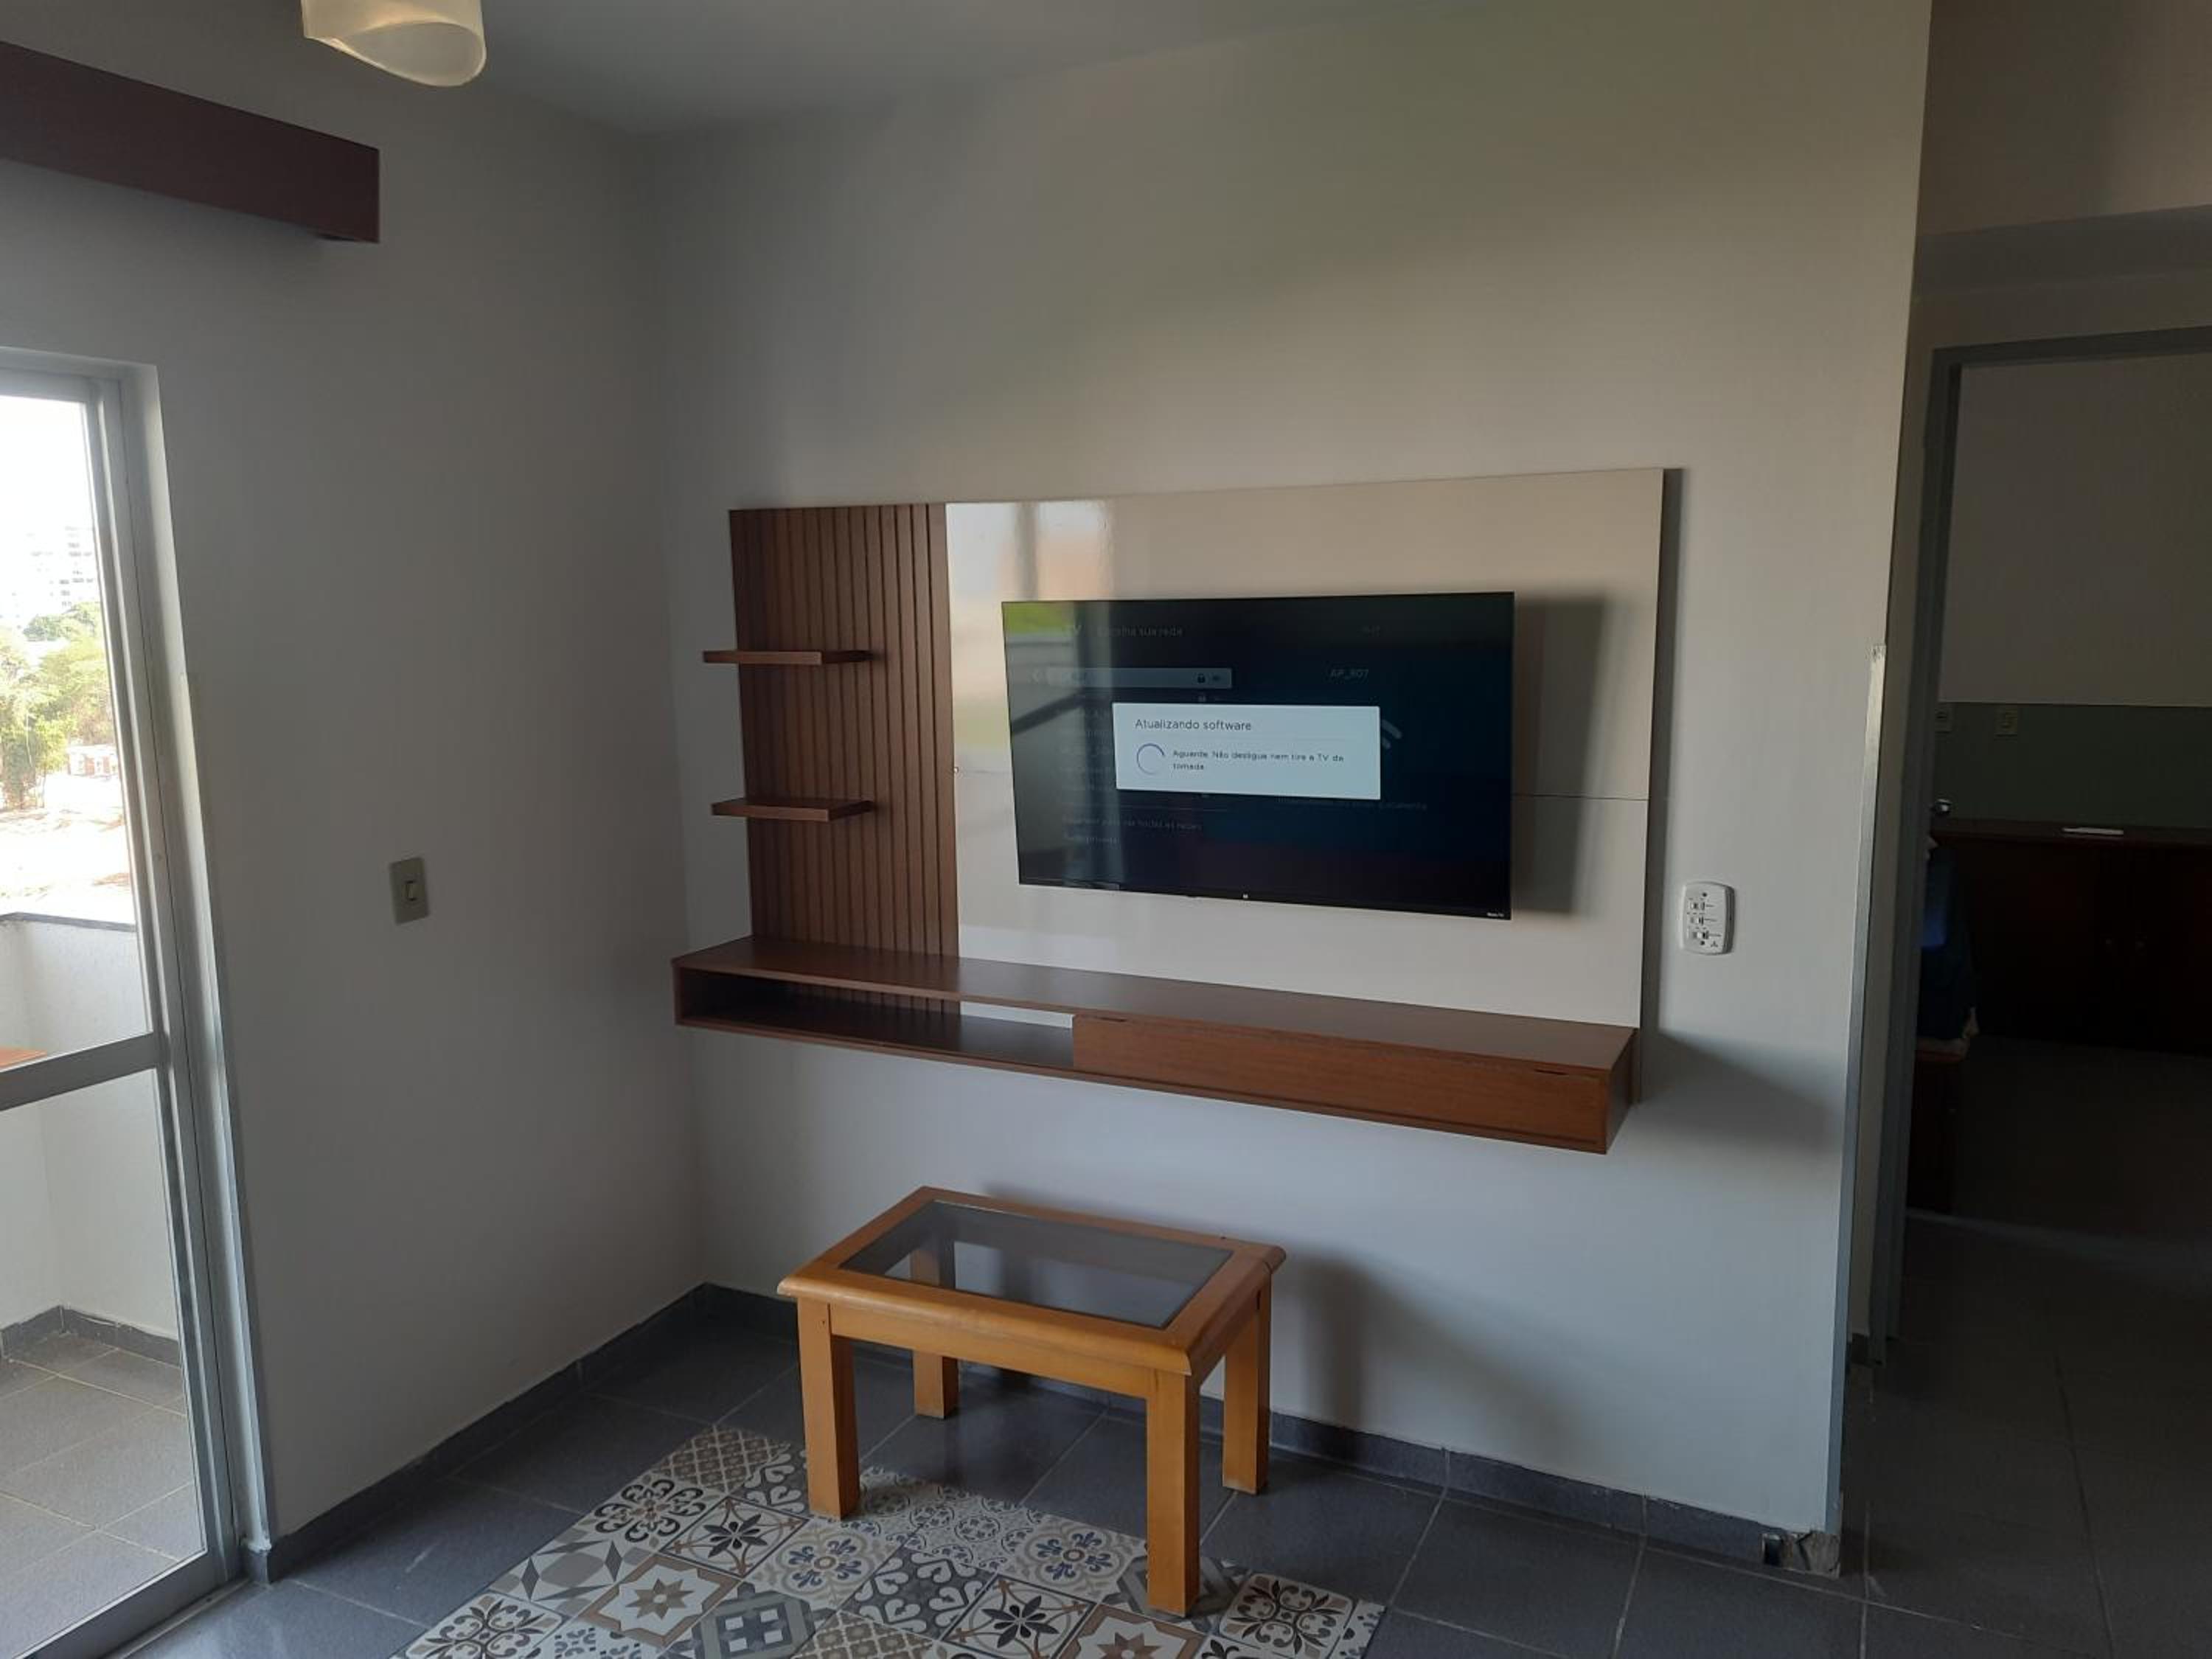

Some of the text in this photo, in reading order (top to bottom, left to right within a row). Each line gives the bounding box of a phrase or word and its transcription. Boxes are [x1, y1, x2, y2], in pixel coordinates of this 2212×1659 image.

[1135, 719, 1252, 731] Atualizando software
[1317, 752, 1329, 761] TV
